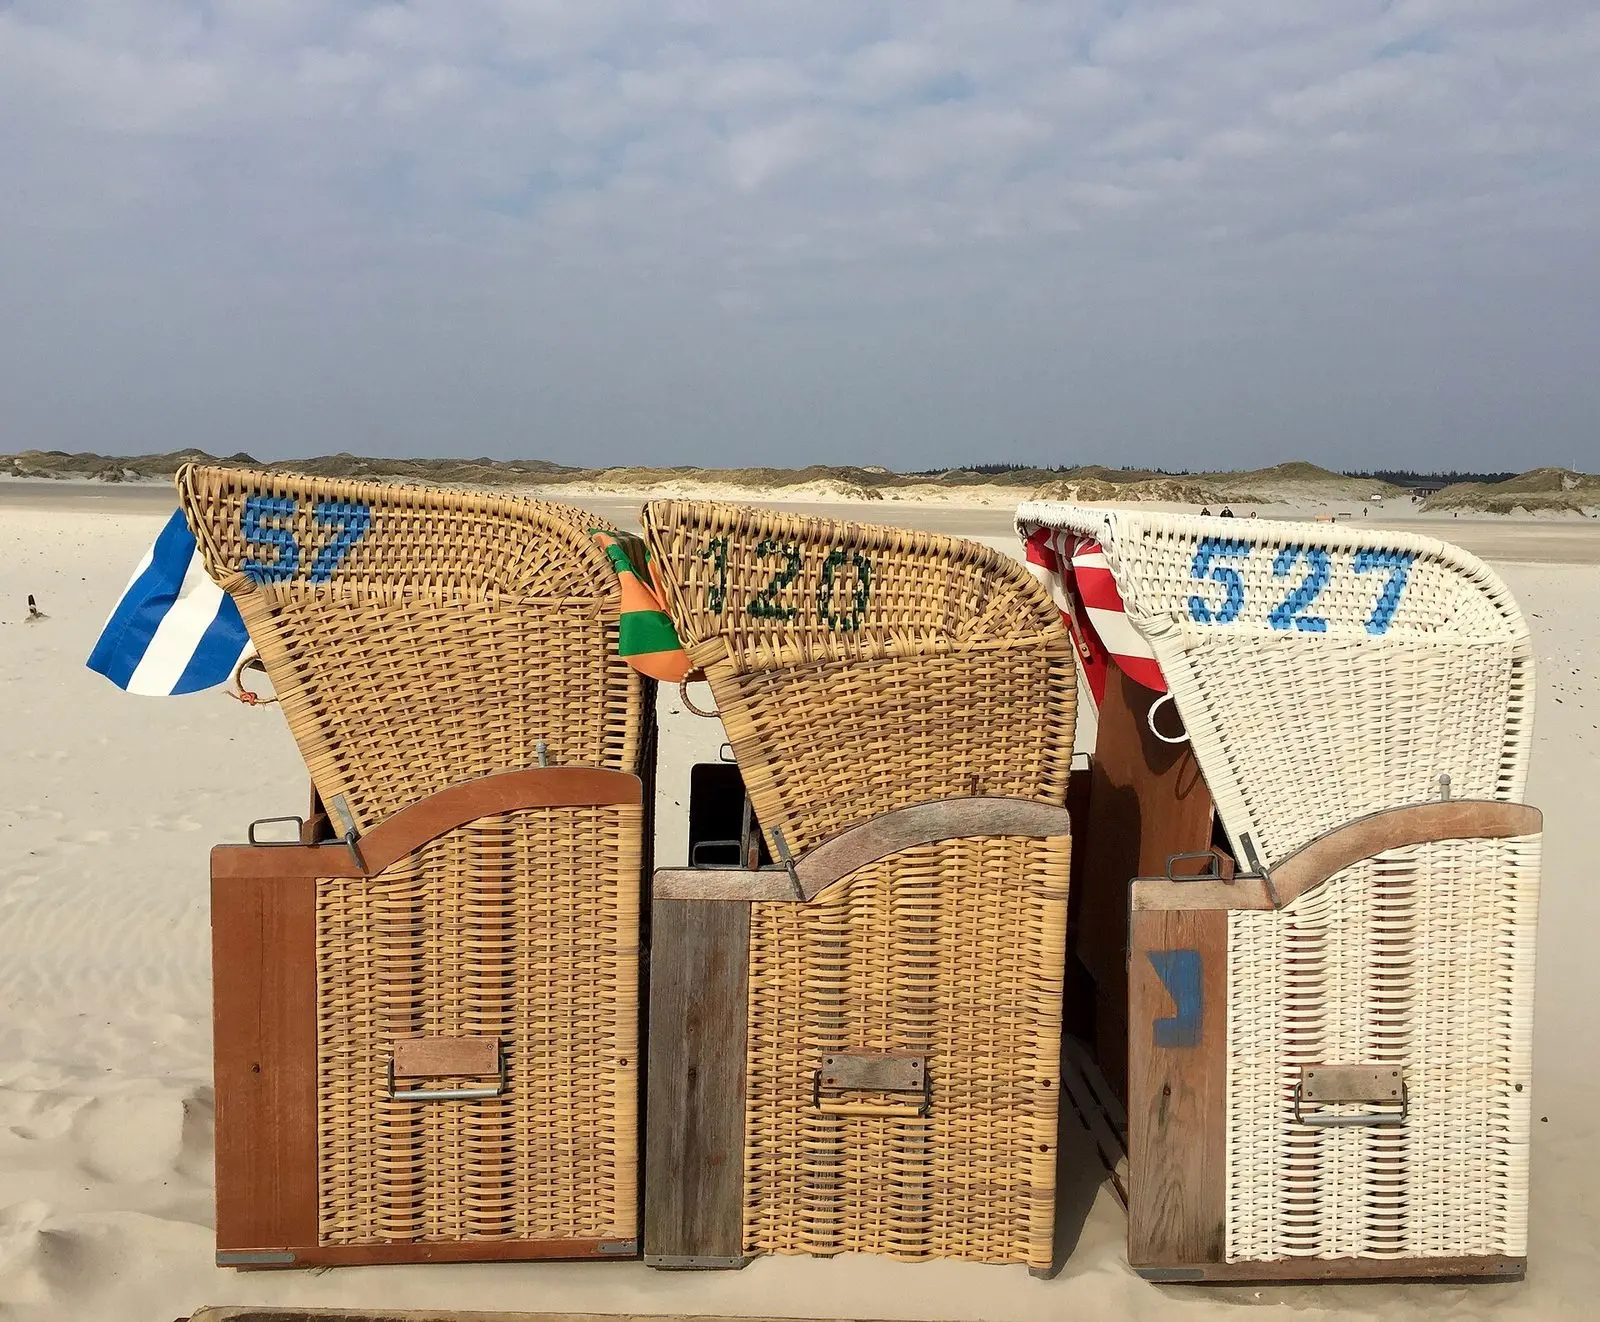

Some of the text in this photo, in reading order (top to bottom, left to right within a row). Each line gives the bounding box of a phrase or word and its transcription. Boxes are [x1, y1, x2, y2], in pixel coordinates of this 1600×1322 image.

[242, 496, 370, 582] 57
[697, 538, 871, 631] 120
[1188, 537, 1412, 635] 527
